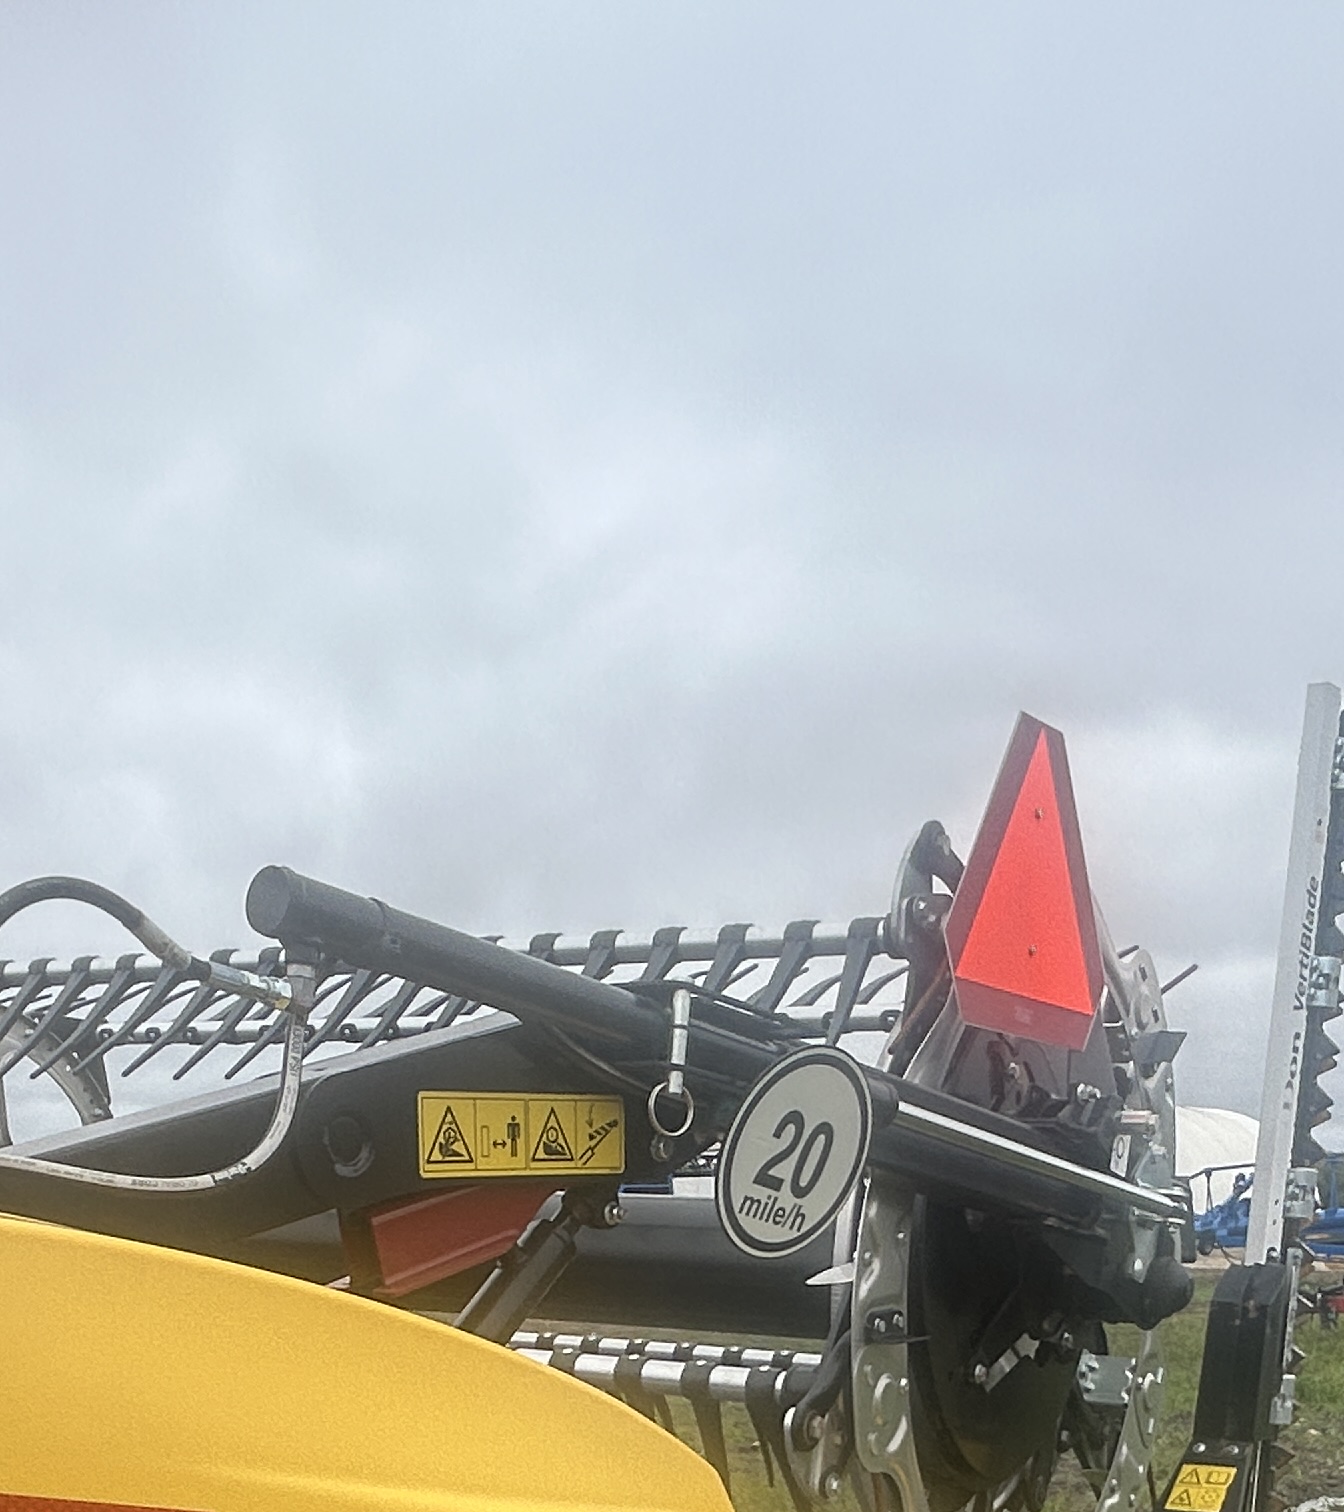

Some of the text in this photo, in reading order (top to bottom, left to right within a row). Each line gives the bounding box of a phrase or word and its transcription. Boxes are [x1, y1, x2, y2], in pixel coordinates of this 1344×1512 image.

[1293, 876, 1319, 1011] VertiBlade
[752, 1109, 834, 1199] 20
[738, 1194, 806, 1233] mile/h
